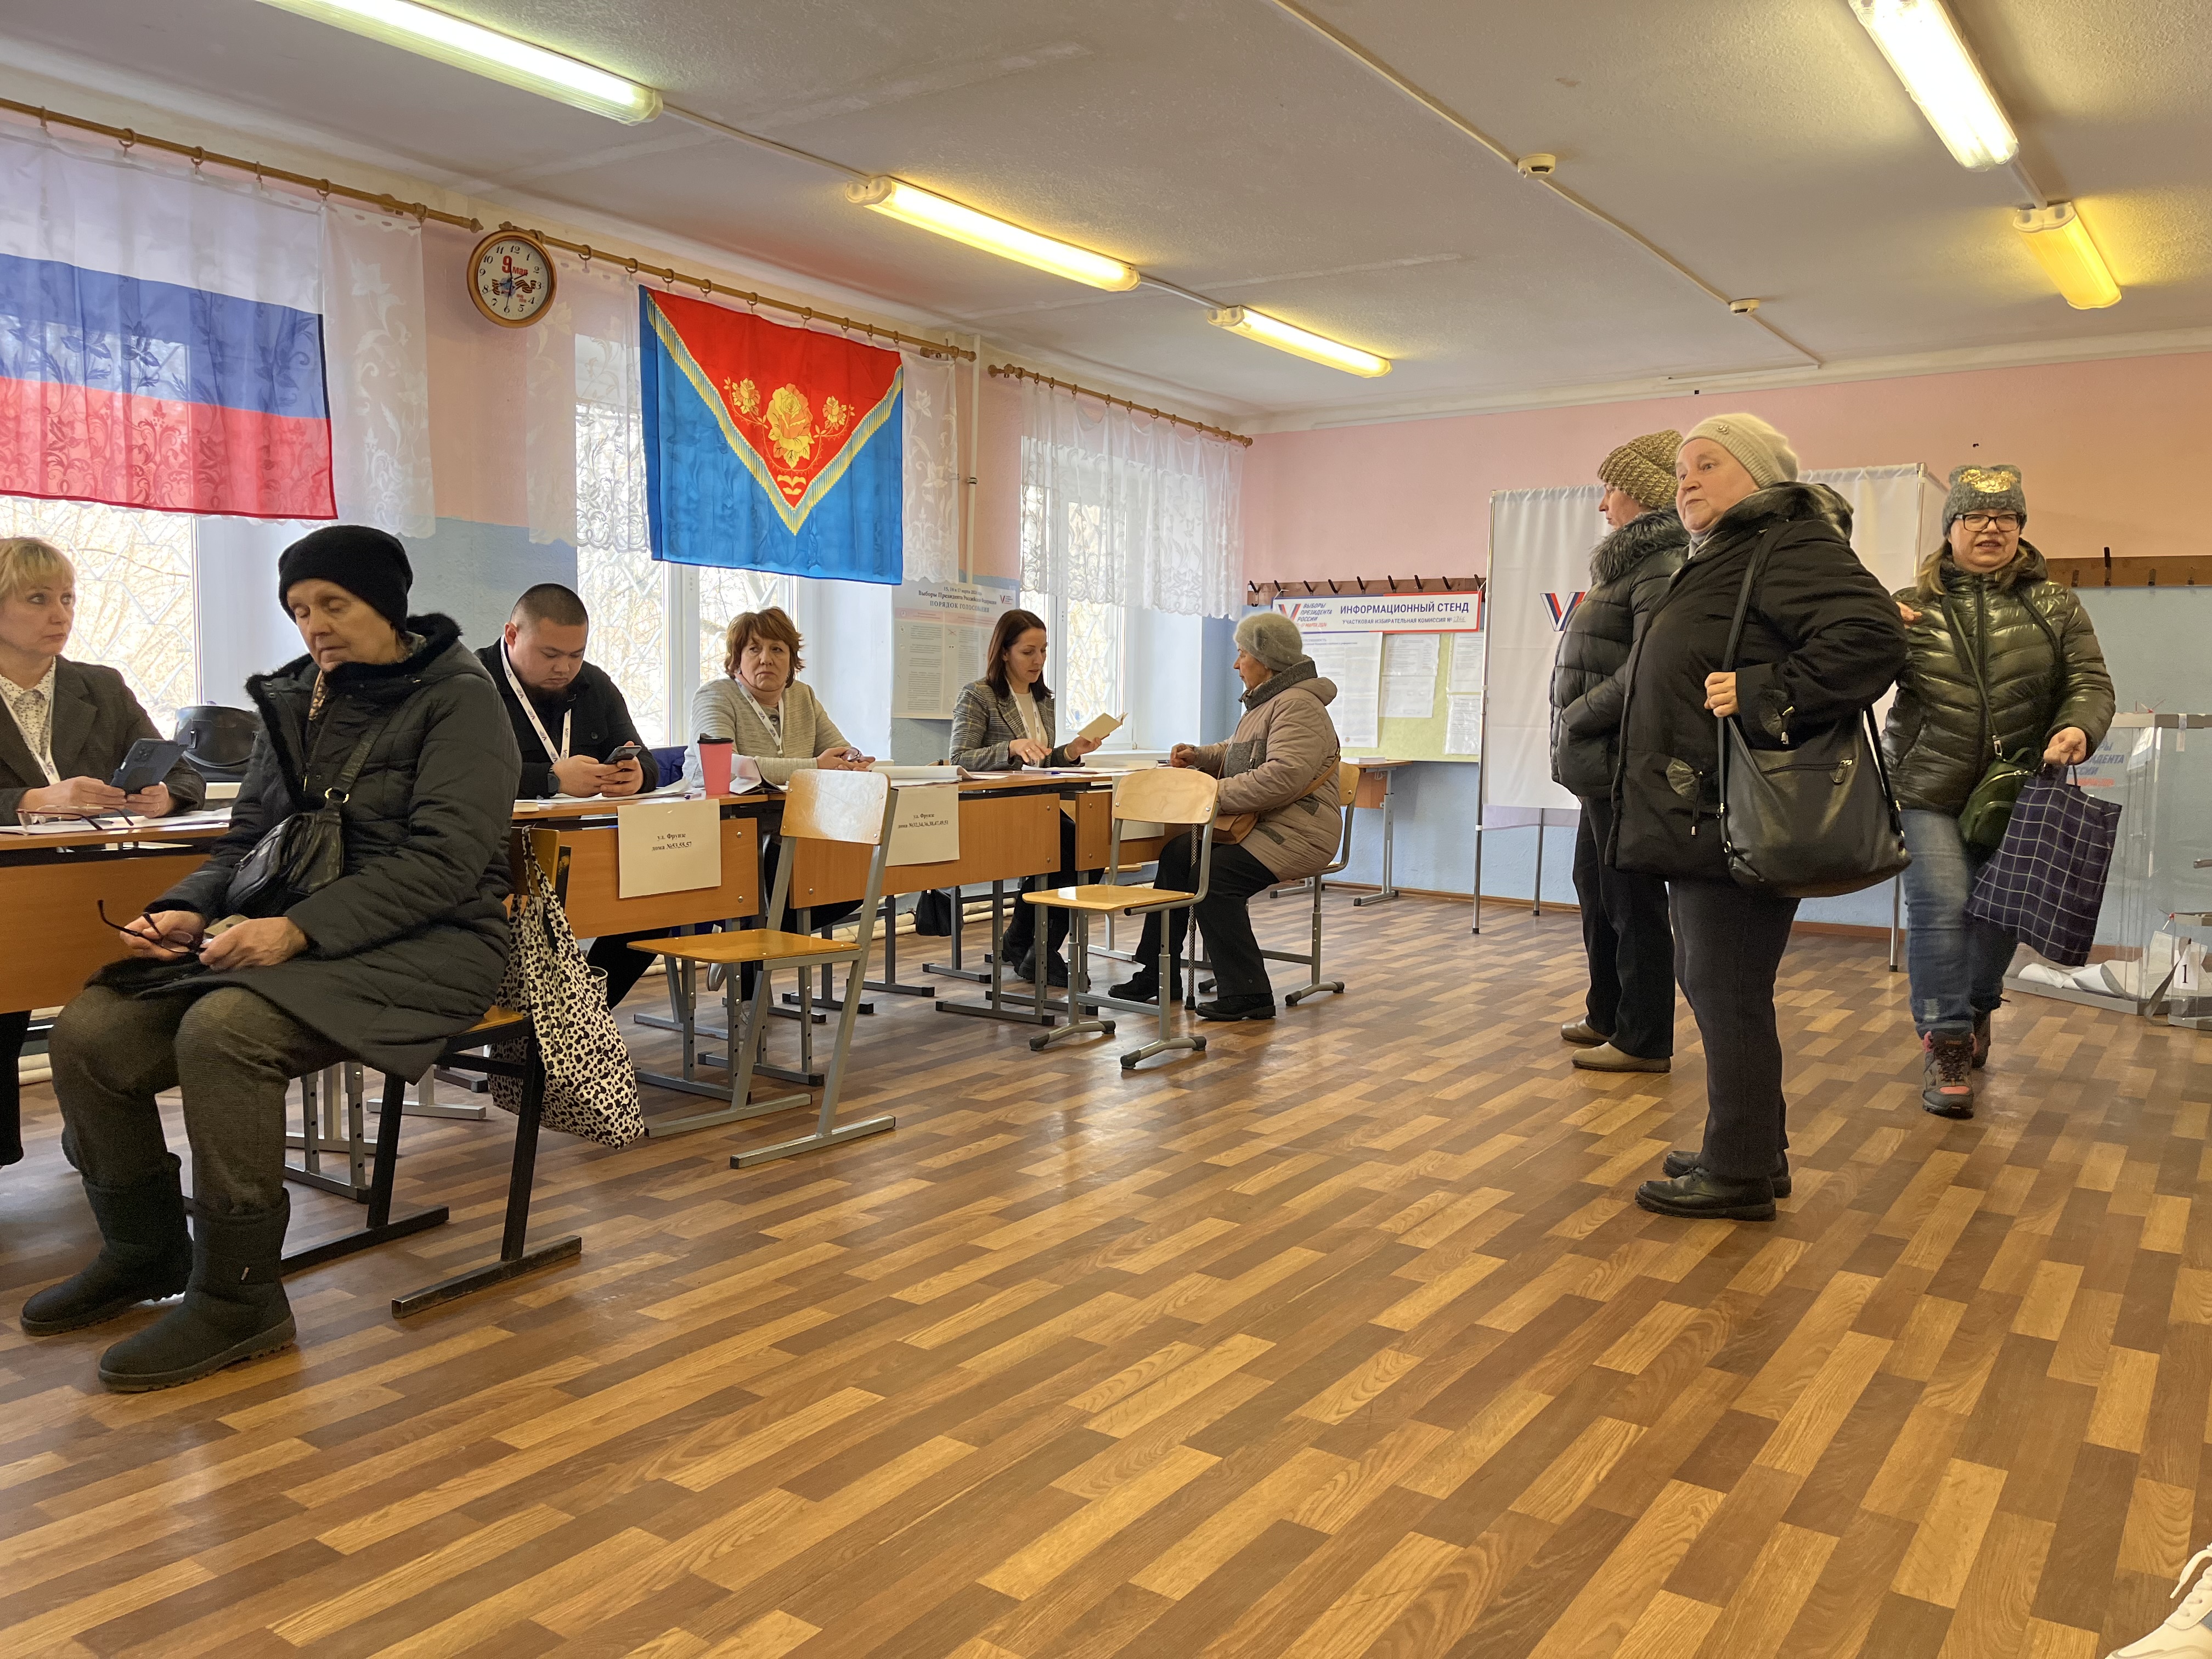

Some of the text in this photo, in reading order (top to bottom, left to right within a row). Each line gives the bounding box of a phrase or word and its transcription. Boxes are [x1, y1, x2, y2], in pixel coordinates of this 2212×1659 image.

[496, 246, 504, 254] 11
[510, 245, 520, 254] 12
[483, 255, 493, 264] 10
[502, 255, 512, 273] 9
[482, 285, 489, 294] 8
[535, 281, 541, 290] 3
[491, 298, 498, 306] 7
[518, 304, 524, 312] 5
[930, 600, 958, 608] ПОРЯДОК
[1340, 601, 1469, 614] ИНФОРМАЦИОННЫЙ СТЕНД
[2182, 964, 2188, 984] 1
